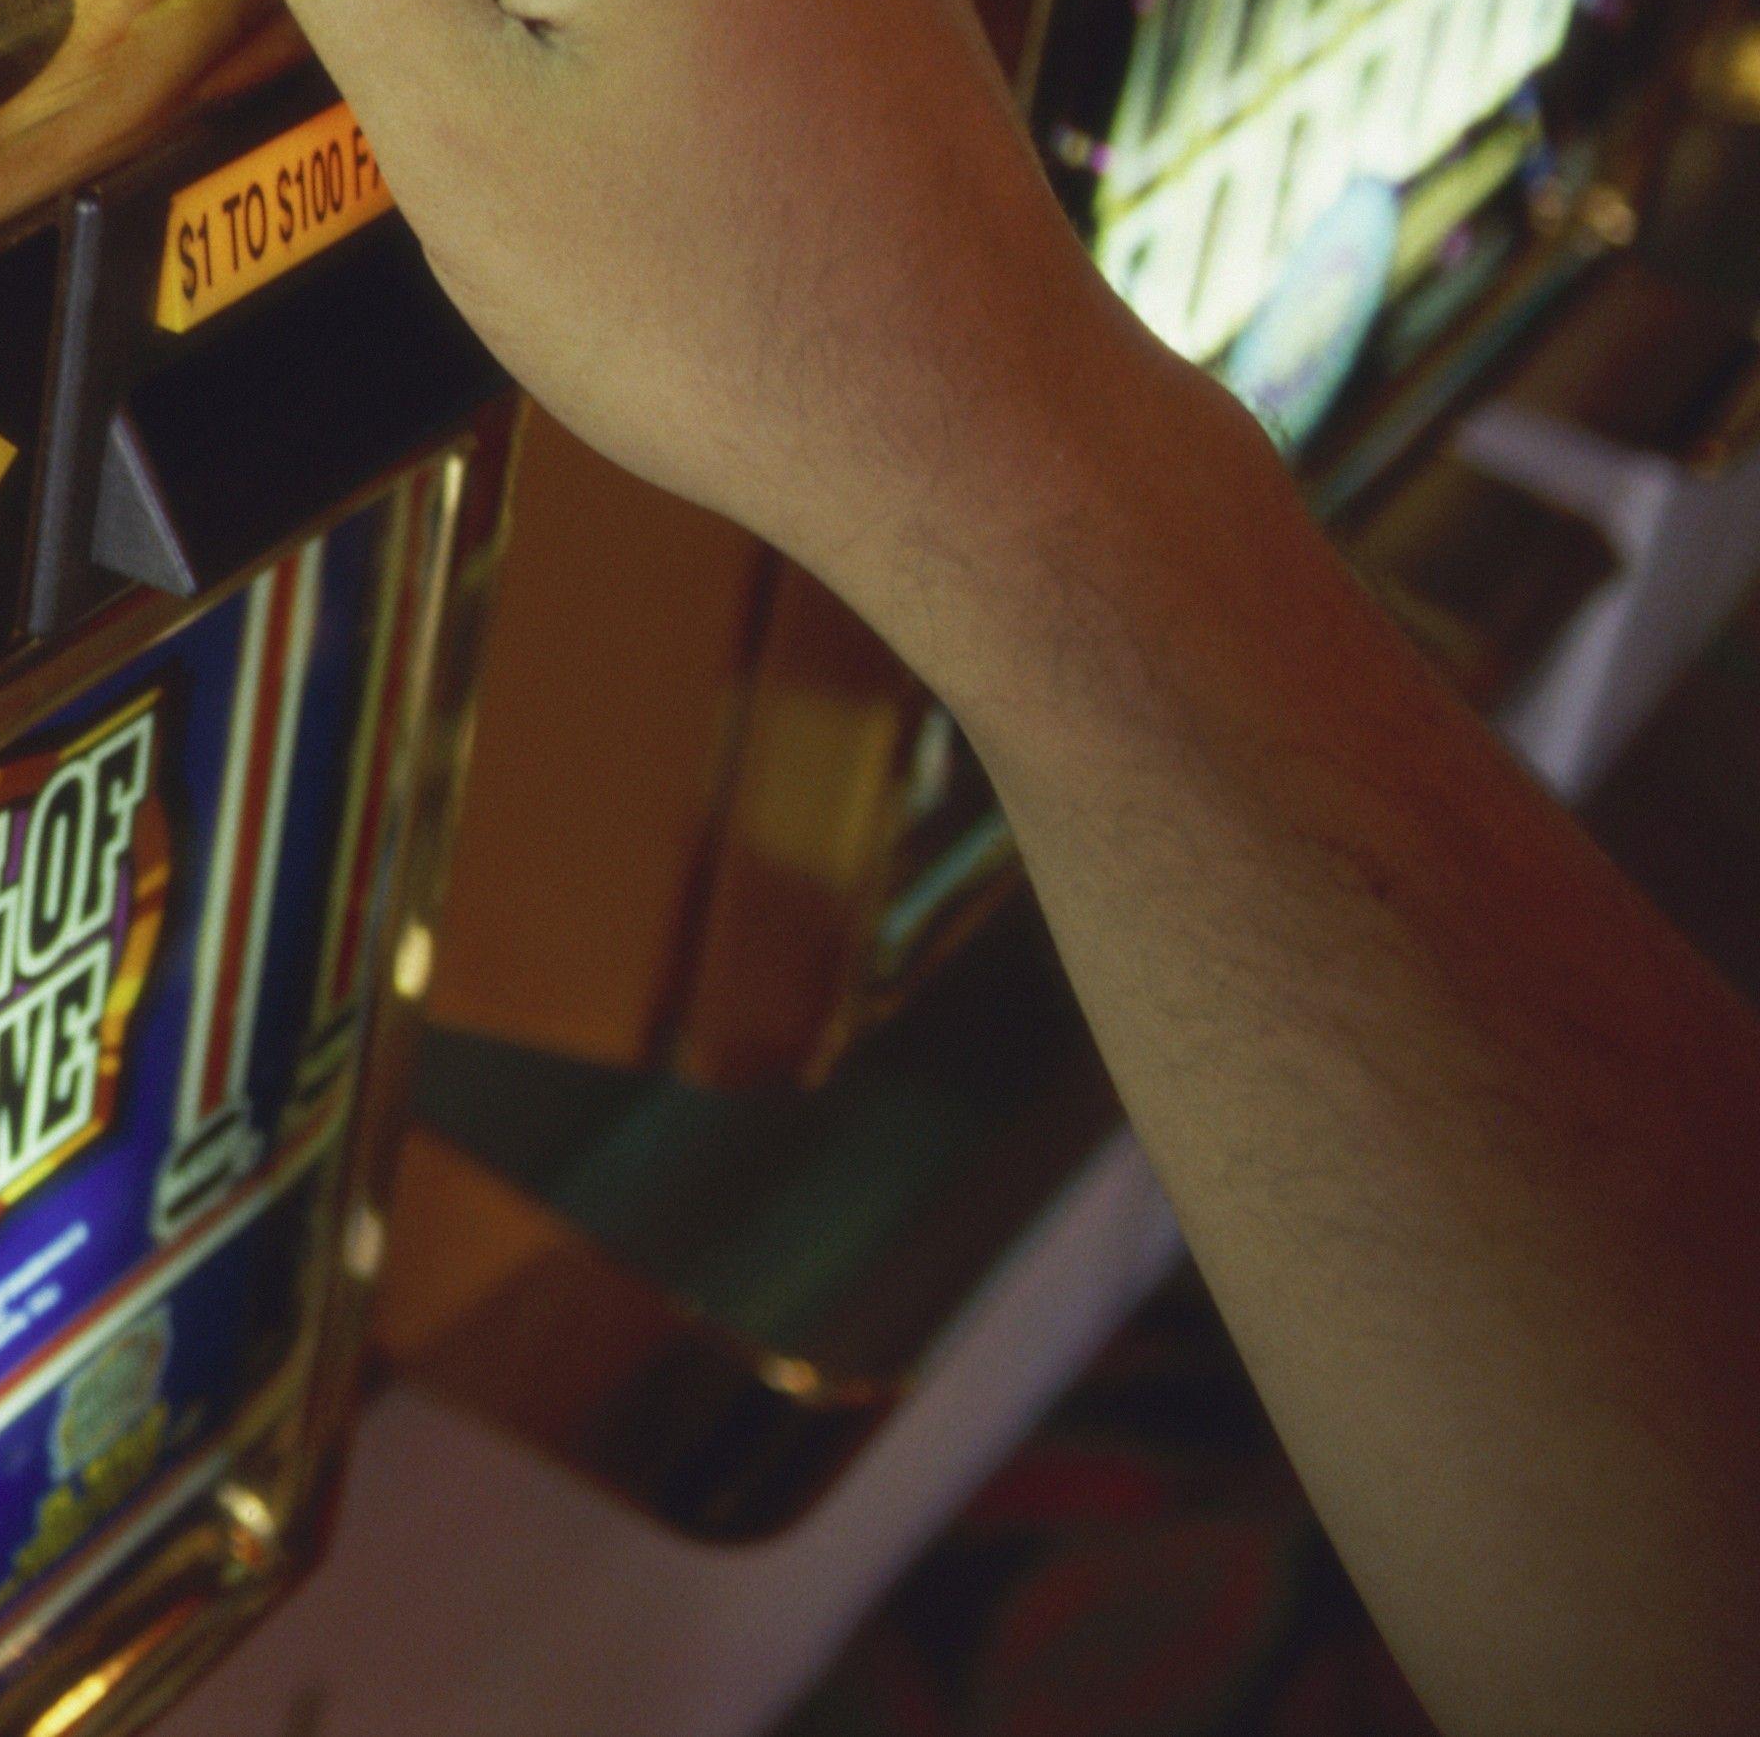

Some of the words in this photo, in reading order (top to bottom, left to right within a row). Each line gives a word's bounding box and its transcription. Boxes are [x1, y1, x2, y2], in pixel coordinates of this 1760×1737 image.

[178, 212, 212, 303] $1
[221, 180, 268, 272] TO
[276, 138, 345, 244] $100
[13, 713, 156, 977] OF
